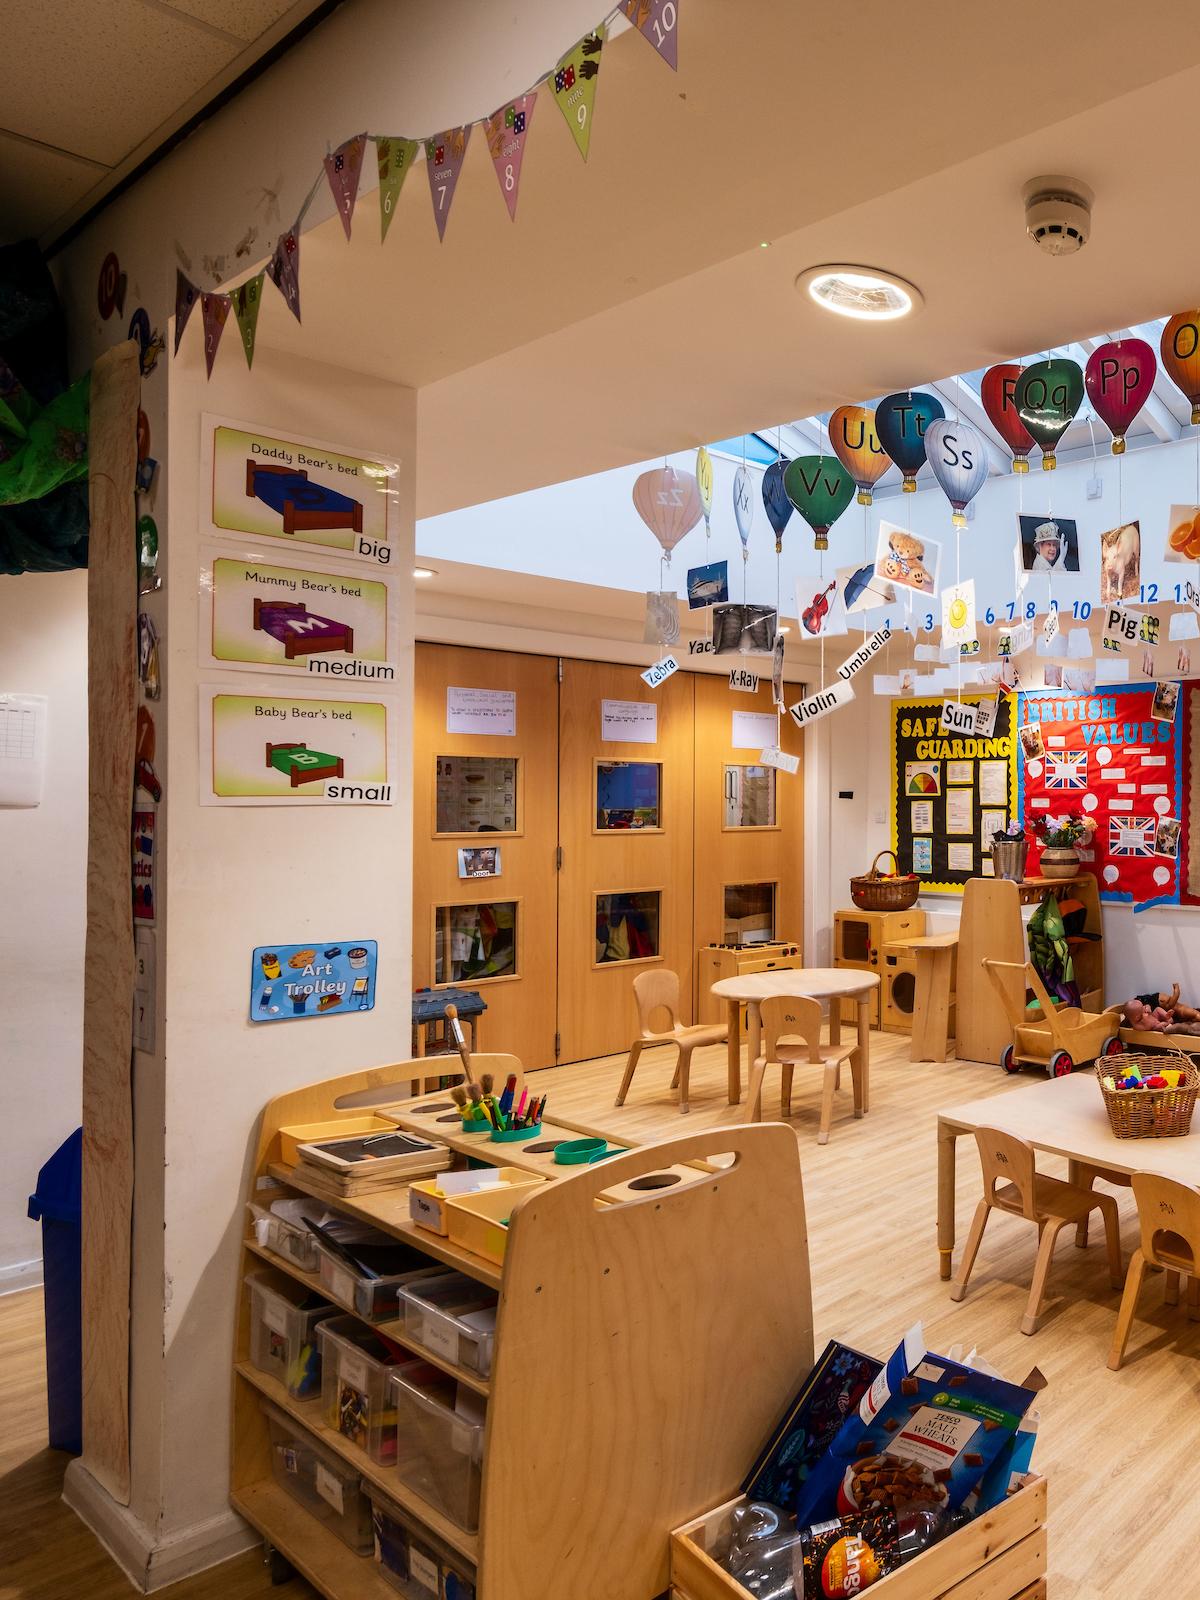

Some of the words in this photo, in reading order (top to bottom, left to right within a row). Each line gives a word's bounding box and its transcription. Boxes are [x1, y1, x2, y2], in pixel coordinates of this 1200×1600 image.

[653, 1, 677, 48] 10
[577, 104, 587, 130] 9
[503, 139, 520, 157] eight
[434, 169, 452, 182] seven
[505, 164, 515, 192] 8
[384, 191, 391, 213] 6
[437, 185, 447, 210] 7
[1100, 358, 1140, 405] Pp
[1024, 378, 1071, 418] Qq
[893, 406, 926, 438] Tt
[251, 442, 293, 464] Daddy
[298, 453, 333, 472] Bear's
[337, 459, 359, 477] bed
[942, 434, 973, 471] Ss
[699, 455, 710, 501] Yy
[800, 468, 841, 498] Vv
[737, 478, 749, 514] Xx
[358, 537, 391, 564] big
[245, 570, 297, 591] Mummy
[302, 579, 337, 595] Bear's
[341, 584, 362, 598] bed
[1140, 583, 1158, 603] 12
[985, 608, 995, 624] 6
[1006, 602, 1015, 619] 7
[1026, 602, 1035, 618] 8
[1073, 601, 1091, 619] 10
[924, 614, 933, 630] 3
[1108, 609, 1138, 639] Pig
[689, 639, 711, 654] Yac
[839, 628, 892, 681] Umbrella
[308, 658, 395, 680] medium
[645, 658, 676, 685] Zebra
[729, 669, 759, 692] X-Ray
[254, 705, 287, 721] Baby
[291, 707, 328, 721] Bear's
[331, 708, 353, 721] bed
[790, 691, 837, 722] Violin
[943, 705, 973, 730] Sun
[1027, 698, 1117, 723] BRITISH
[1081, 722, 1171, 745] VALUES
[916, 737, 1011, 760] GUARDING
[327, 781, 391, 802] small
[302, 963, 334, 977] Art
[284, 979, 347, 996] Trolley
[926, 1420, 958, 1434] MALT
[935, 1413, 961, 1424] TESCO
[914, 1425, 958, 1446] WHEATS
